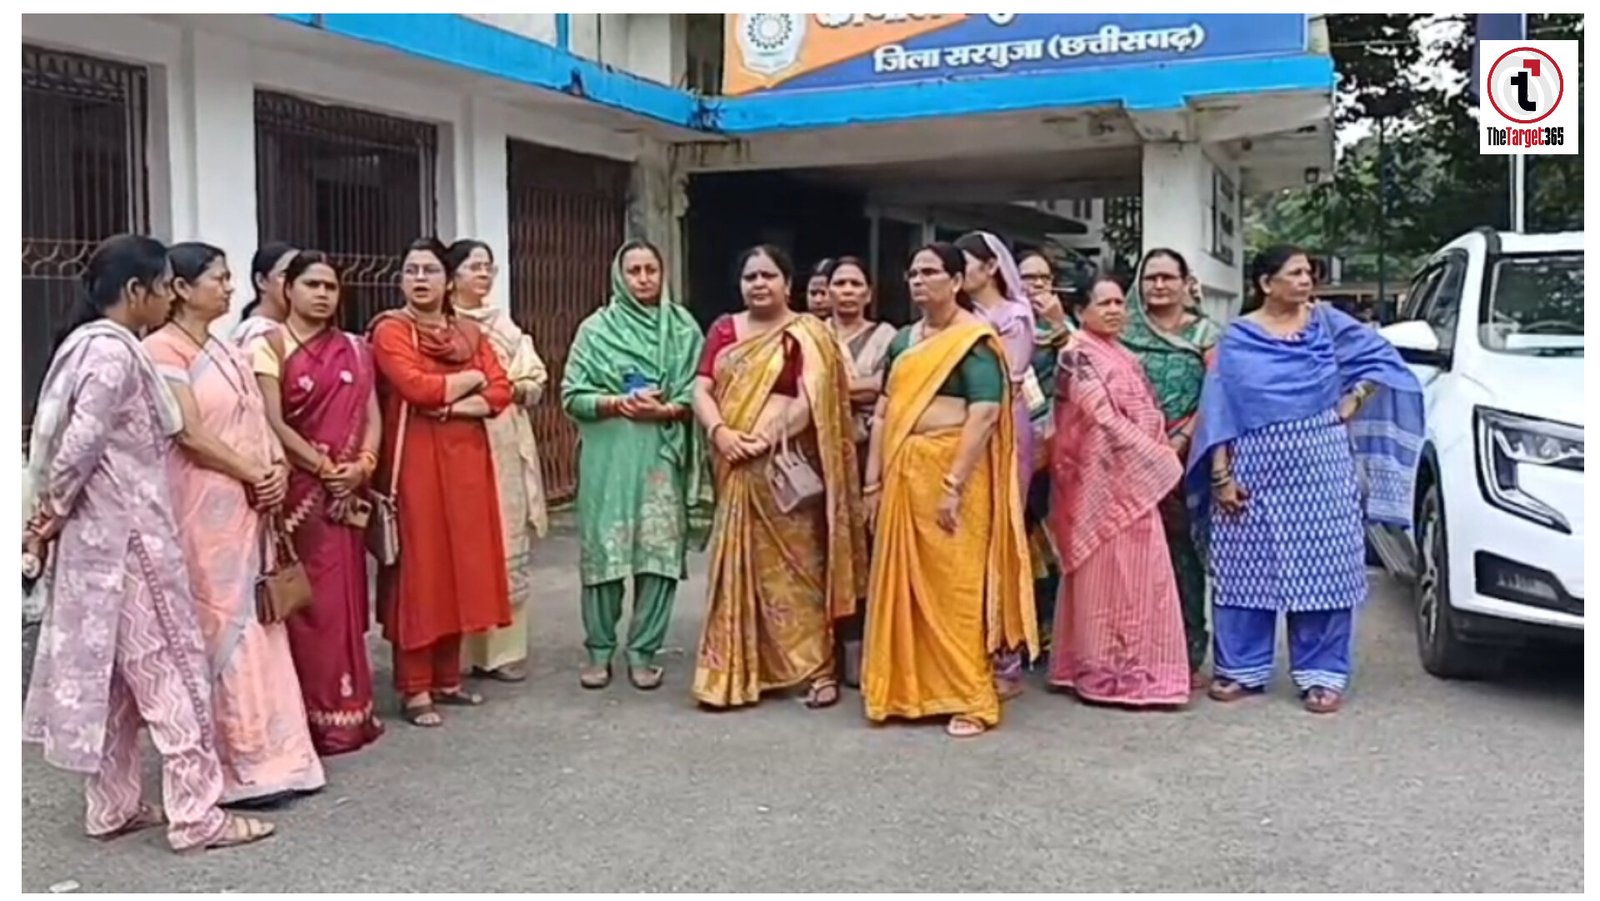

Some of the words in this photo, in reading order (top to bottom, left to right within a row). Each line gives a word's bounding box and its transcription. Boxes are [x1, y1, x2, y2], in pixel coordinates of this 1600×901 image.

[873, 44, 941, 73] जिला
[944, 38, 1045, 69] सरगुजा
[1047, 22, 1206, 59] (छत्तीसगढ़)
